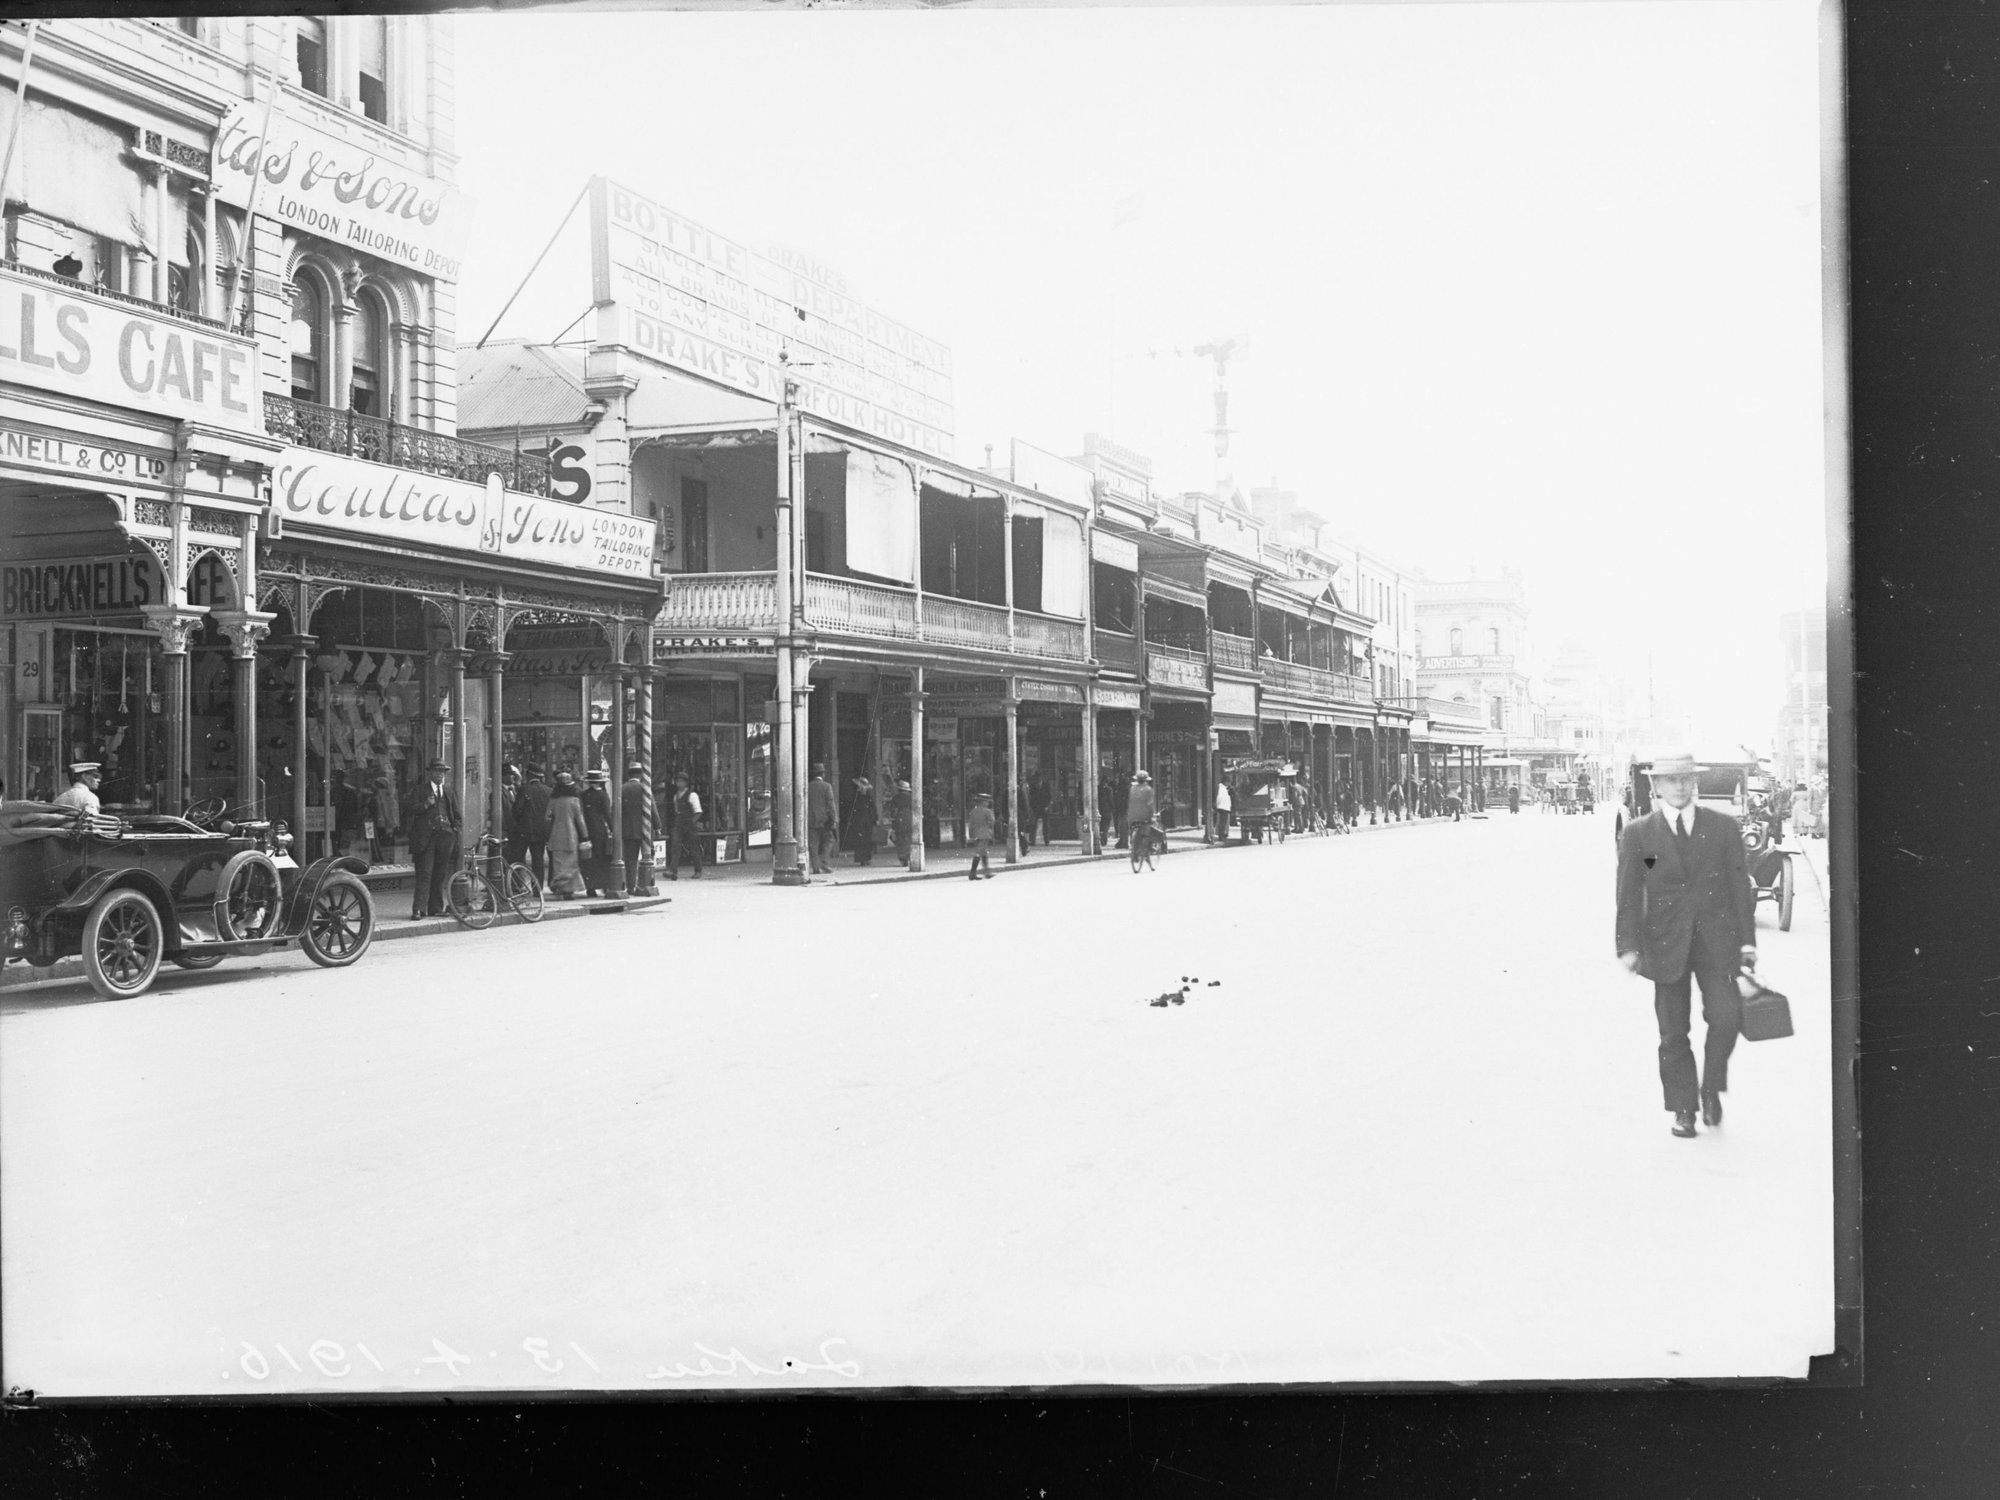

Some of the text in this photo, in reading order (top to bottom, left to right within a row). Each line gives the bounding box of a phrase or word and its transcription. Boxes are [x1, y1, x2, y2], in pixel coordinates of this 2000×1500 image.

[300, 151, 336, 191] &
[334, 157, 452, 227] Sons
[278, 194, 462, 277] LONDON TAILORING DEPOT
[613, 187, 946, 371] BOTTLE DEPARTMENT
[635, 253, 670, 282] ALL
[682, 274, 749, 316] BRANDS
[761, 309, 778, 328] OF
[641, 237, 704, 278] SINGLE
[715, 271, 781, 313] BOTTLE
[637, 292, 659, 313] TO
[671, 306, 707, 332] ANY
[667, 286, 728, 324] GOODS
[635, 316, 951, 458] DRAKE'S NRFOLK HOTEL
[76, 449, 90, 469] &
[280, 464, 476, 527] Coultas
[506, 503, 585, 545] Sons
[592, 516, 646, 539] LONDON
[593, 536, 651, 559] TAILORING
[3, 560, 150, 614] BRICKNELL'S
[654, 637, 760, 647] DRAKE'S
[703, 647, 776, 655] DEPARTME
[23, 660, 39, 677] 29
[1425, 656, 1479, 670] ADVERTISING
[982, 679, 1006, 692] HOTE
